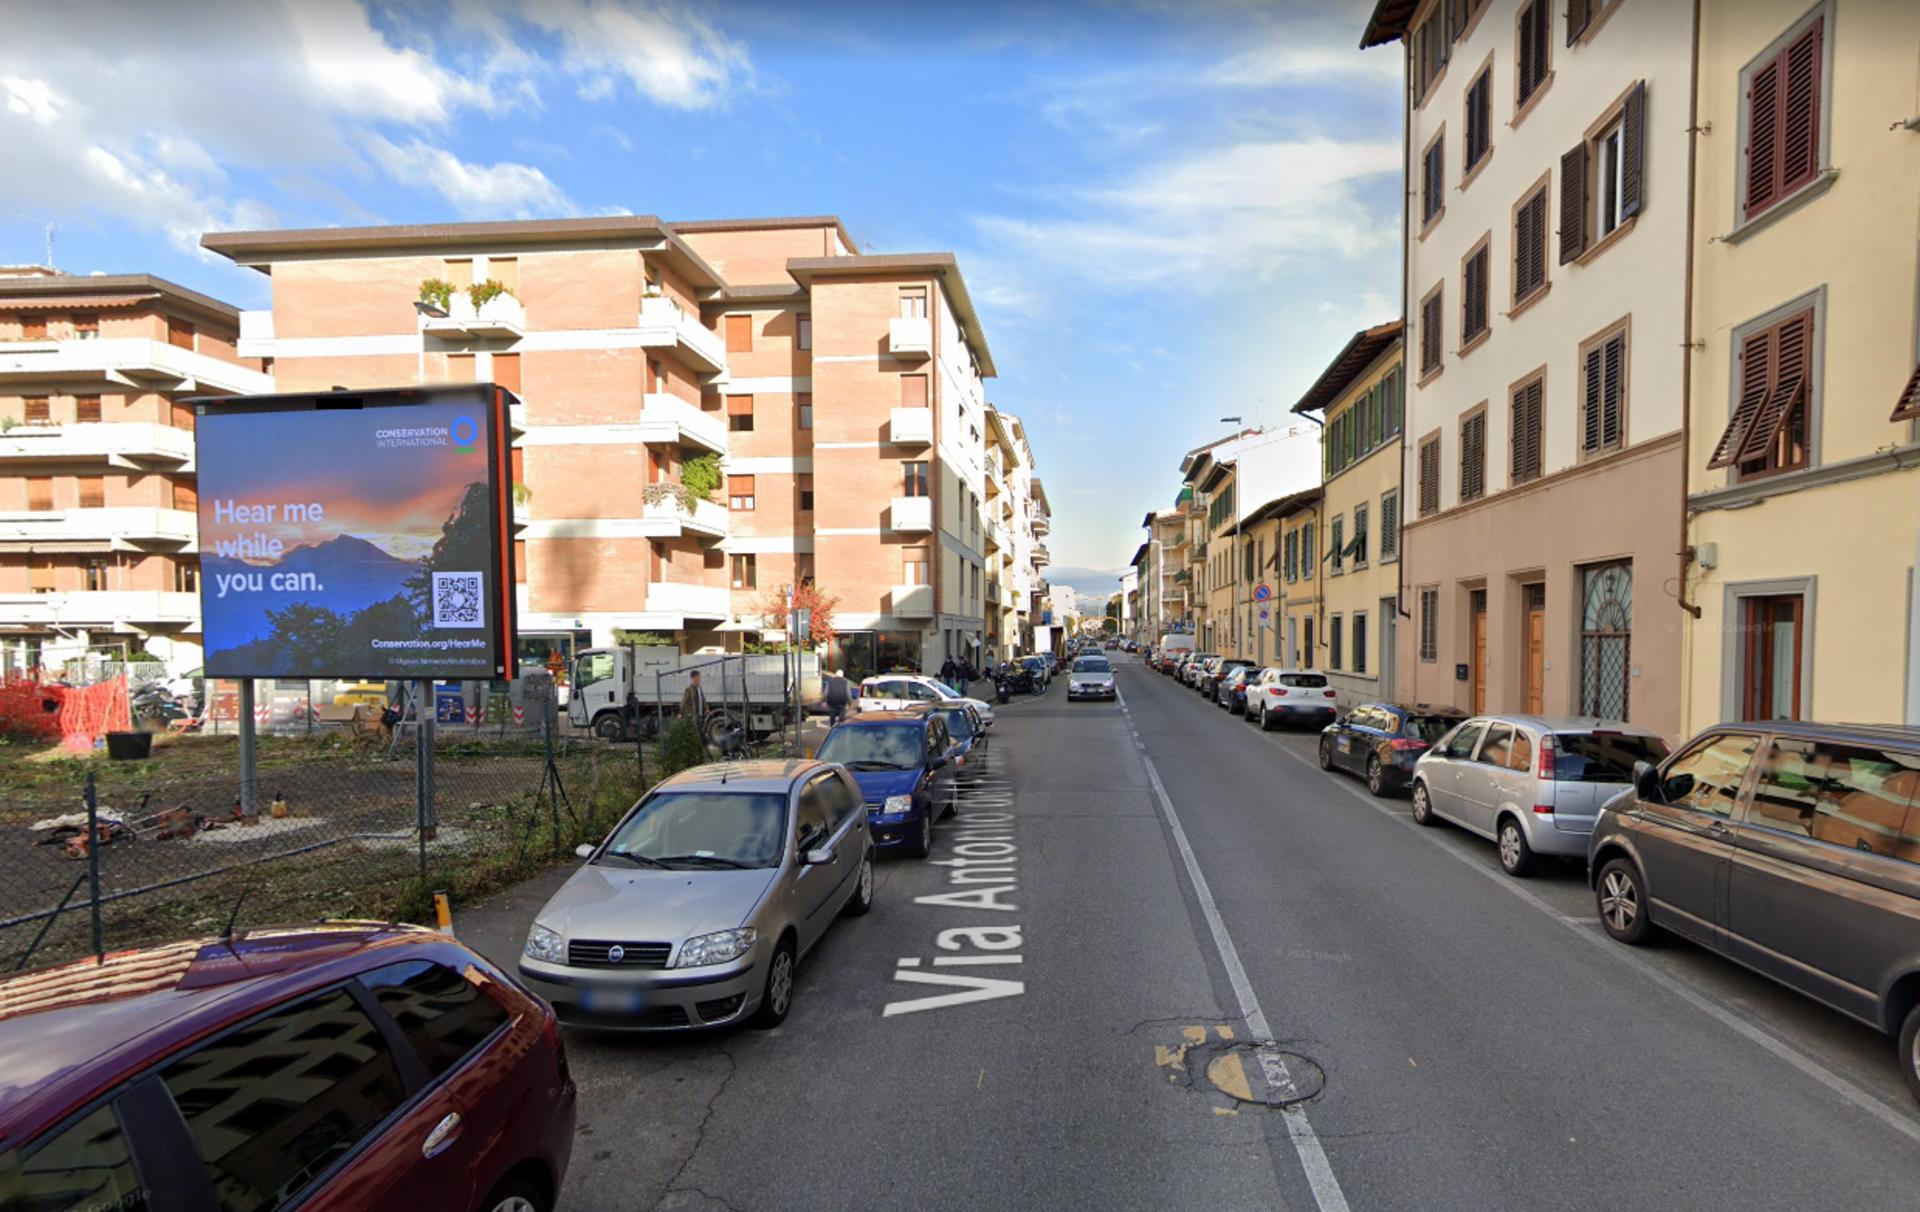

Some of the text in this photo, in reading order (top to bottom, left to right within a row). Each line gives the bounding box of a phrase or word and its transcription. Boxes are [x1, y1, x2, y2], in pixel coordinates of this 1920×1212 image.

[376, 427, 448, 438] CONSERVATION
[376, 437, 448, 448] INTERNATIONAL
[214, 499, 323, 524] Hear me
[215, 533, 284, 558] while
[216, 572, 324, 598] you can.
[371, 639, 486, 650] Conservation.org/HearMe
